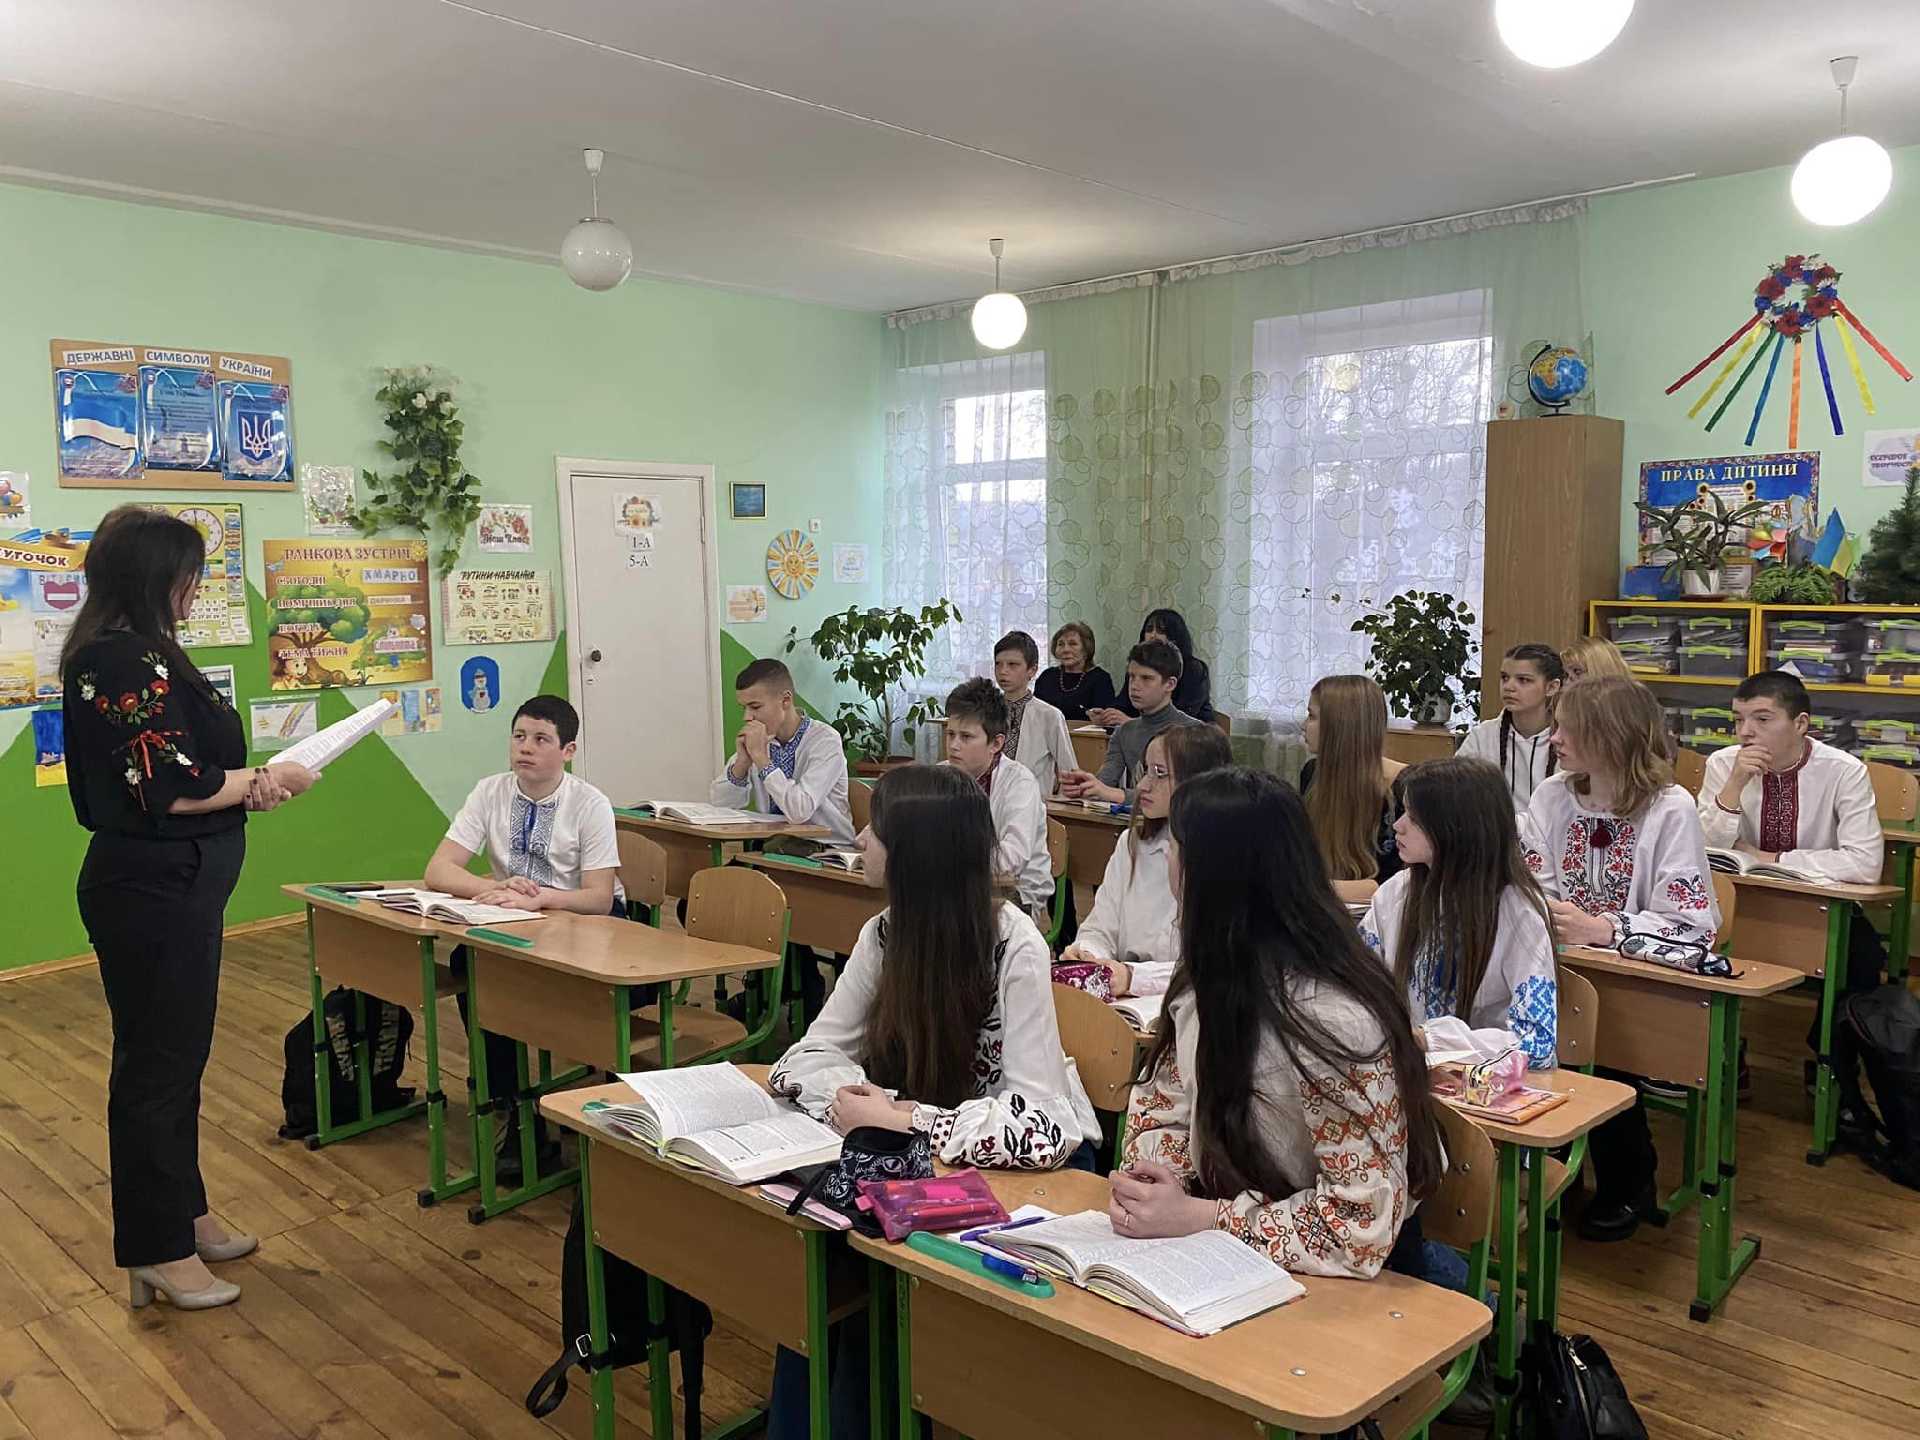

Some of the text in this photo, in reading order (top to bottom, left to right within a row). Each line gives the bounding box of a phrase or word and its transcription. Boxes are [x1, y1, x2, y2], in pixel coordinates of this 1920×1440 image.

[66, 350, 134, 364] ДЕРЖАВНІ
[146, 351, 210, 366] СИМВОЛИ
[222, 358, 271, 378] УКРАЇНИ
[1661, 463, 1798, 482] ПРАВА ДИТИНИ
[284, 548, 410, 560] РАНКОВА ЗУСТРІЧ
[364, 569, 416, 581] ХМАРНО
